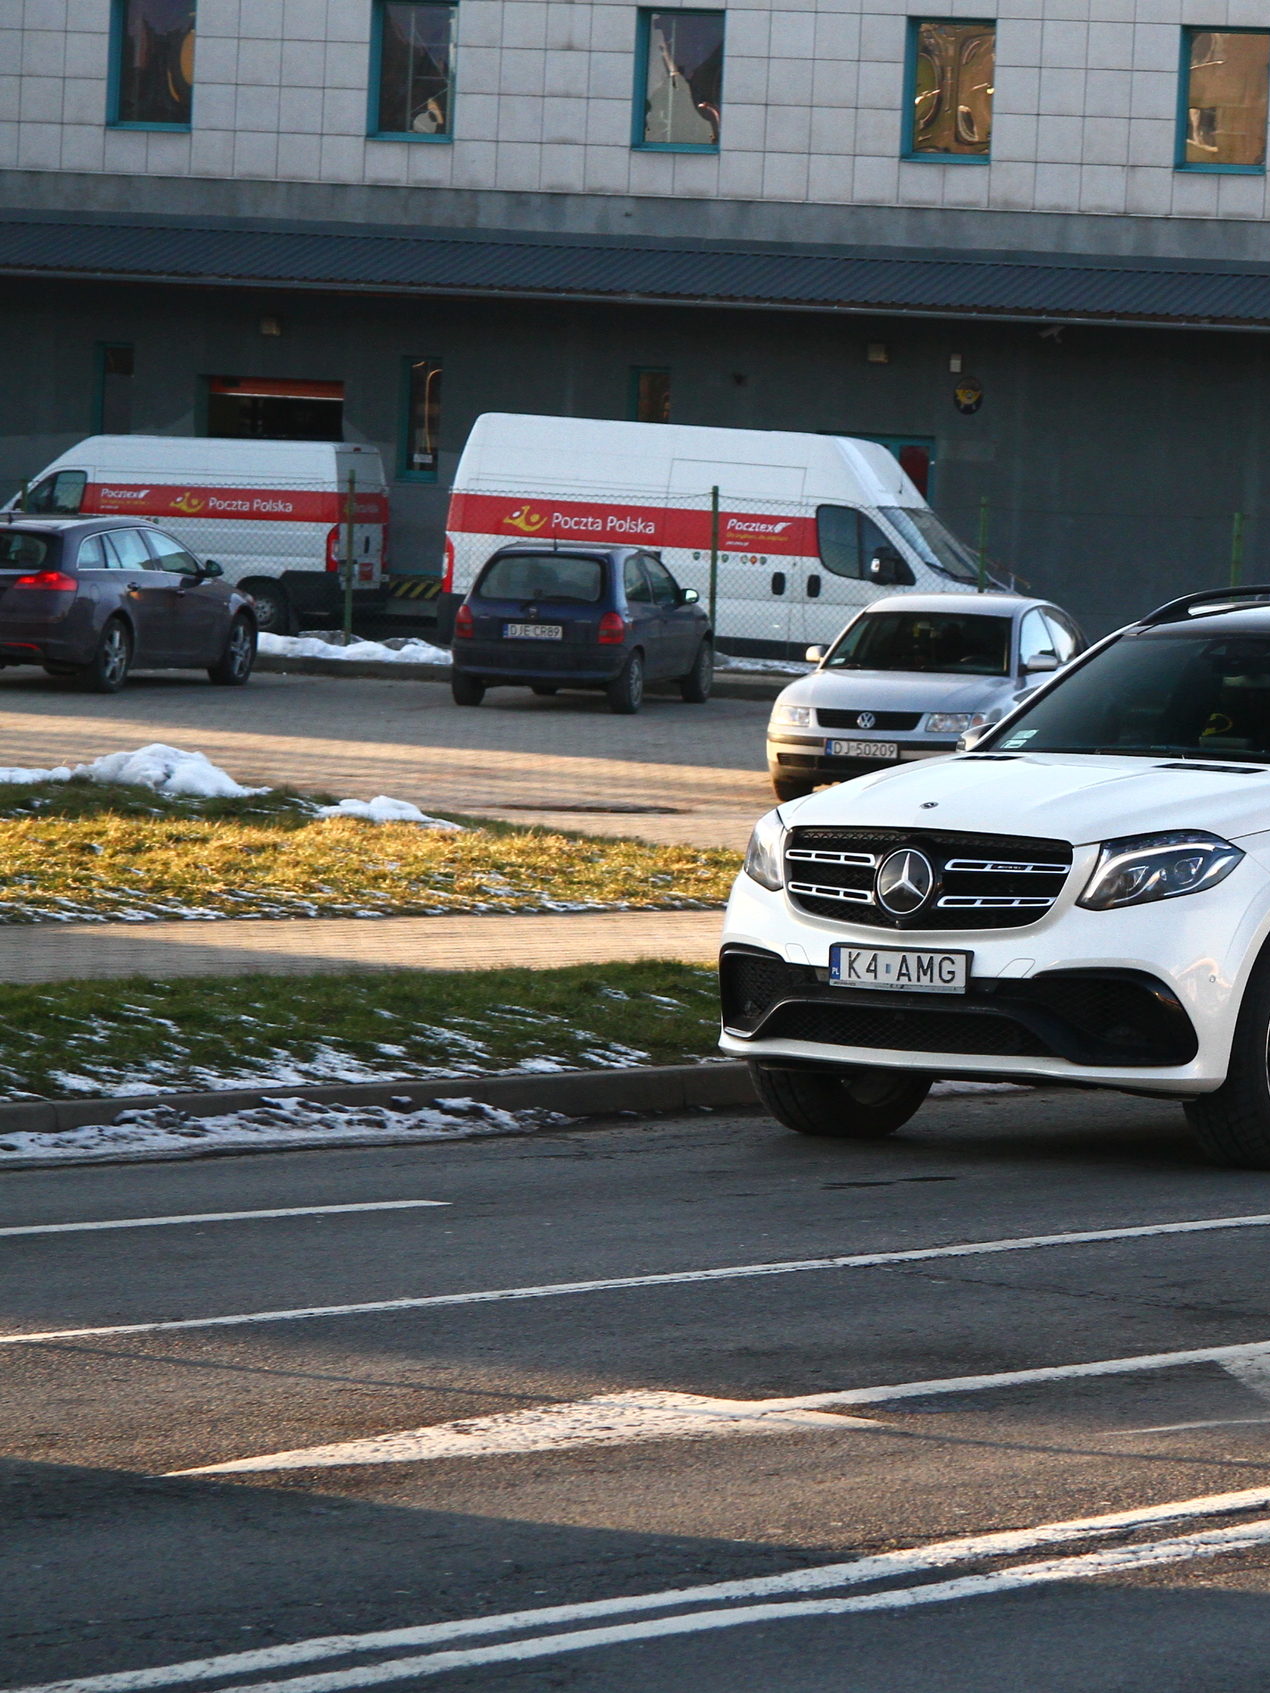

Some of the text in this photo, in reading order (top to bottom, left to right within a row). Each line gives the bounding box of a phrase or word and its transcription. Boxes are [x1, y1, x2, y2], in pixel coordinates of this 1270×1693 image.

[208, 497, 293, 513] Poczta Polska
[552, 512, 655, 534] Poczta Polska
[726, 519, 783, 533] Pocztex
[848, 951, 878, 980] K4
[896, 954, 956, 984] AMG
